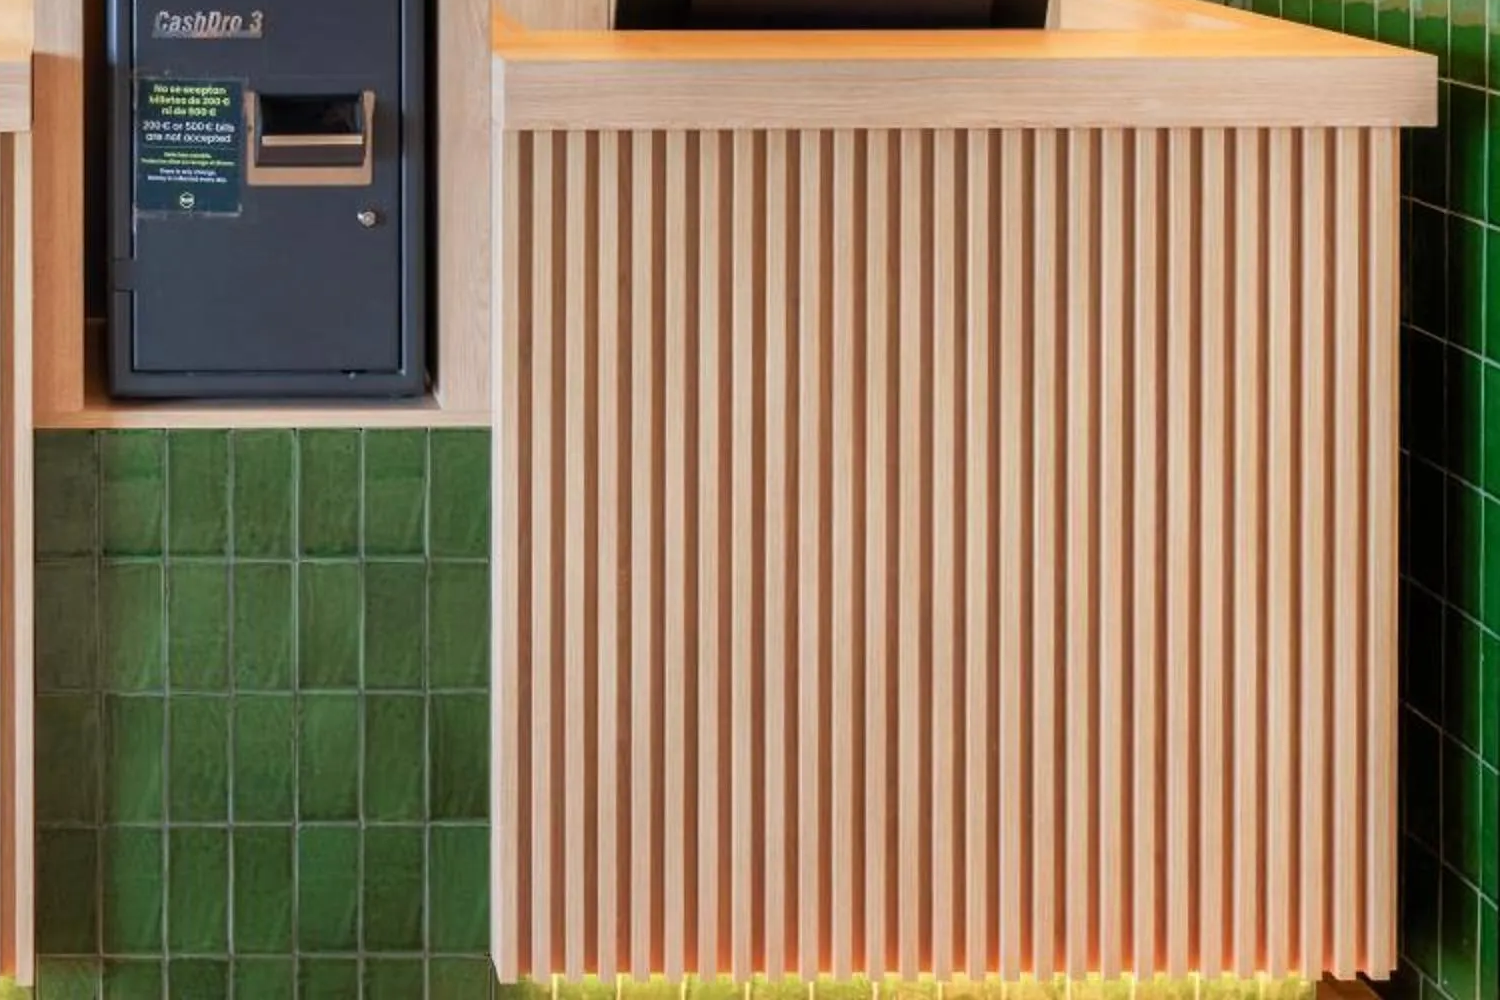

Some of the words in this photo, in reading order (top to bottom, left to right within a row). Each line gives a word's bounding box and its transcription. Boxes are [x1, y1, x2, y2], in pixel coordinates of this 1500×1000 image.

[153, 9, 243, 37] CashDro
[249, 9, 263, 36] 3
[172, 123, 183, 131] or
[185, 121, 204, 131] 500
[164, 133, 181, 141] not
[184, 133, 231, 144] accepted
